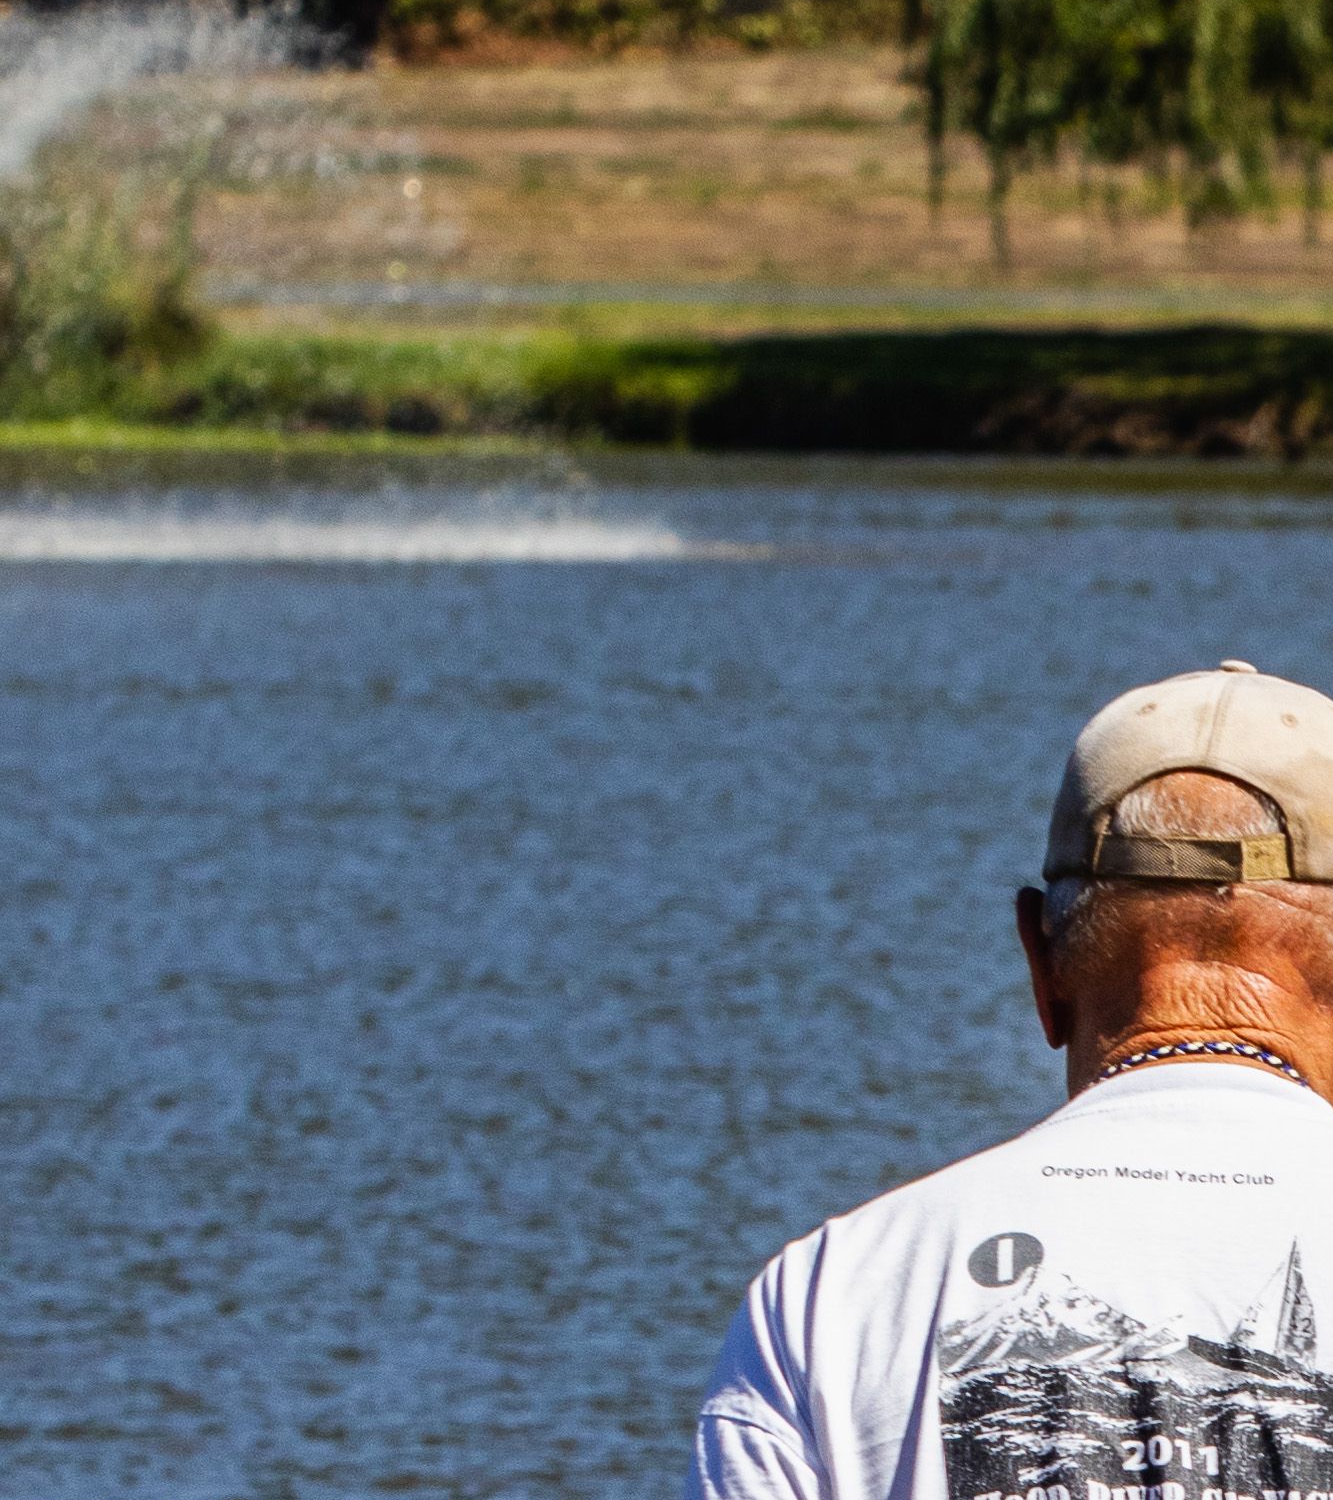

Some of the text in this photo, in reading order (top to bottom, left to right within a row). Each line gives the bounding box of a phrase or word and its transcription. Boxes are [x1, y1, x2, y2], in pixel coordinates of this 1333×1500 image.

[1041, 1165, 1275, 1186] Oregon Model Yacht Club
[1121, 1434, 1219, 1476] 2011
